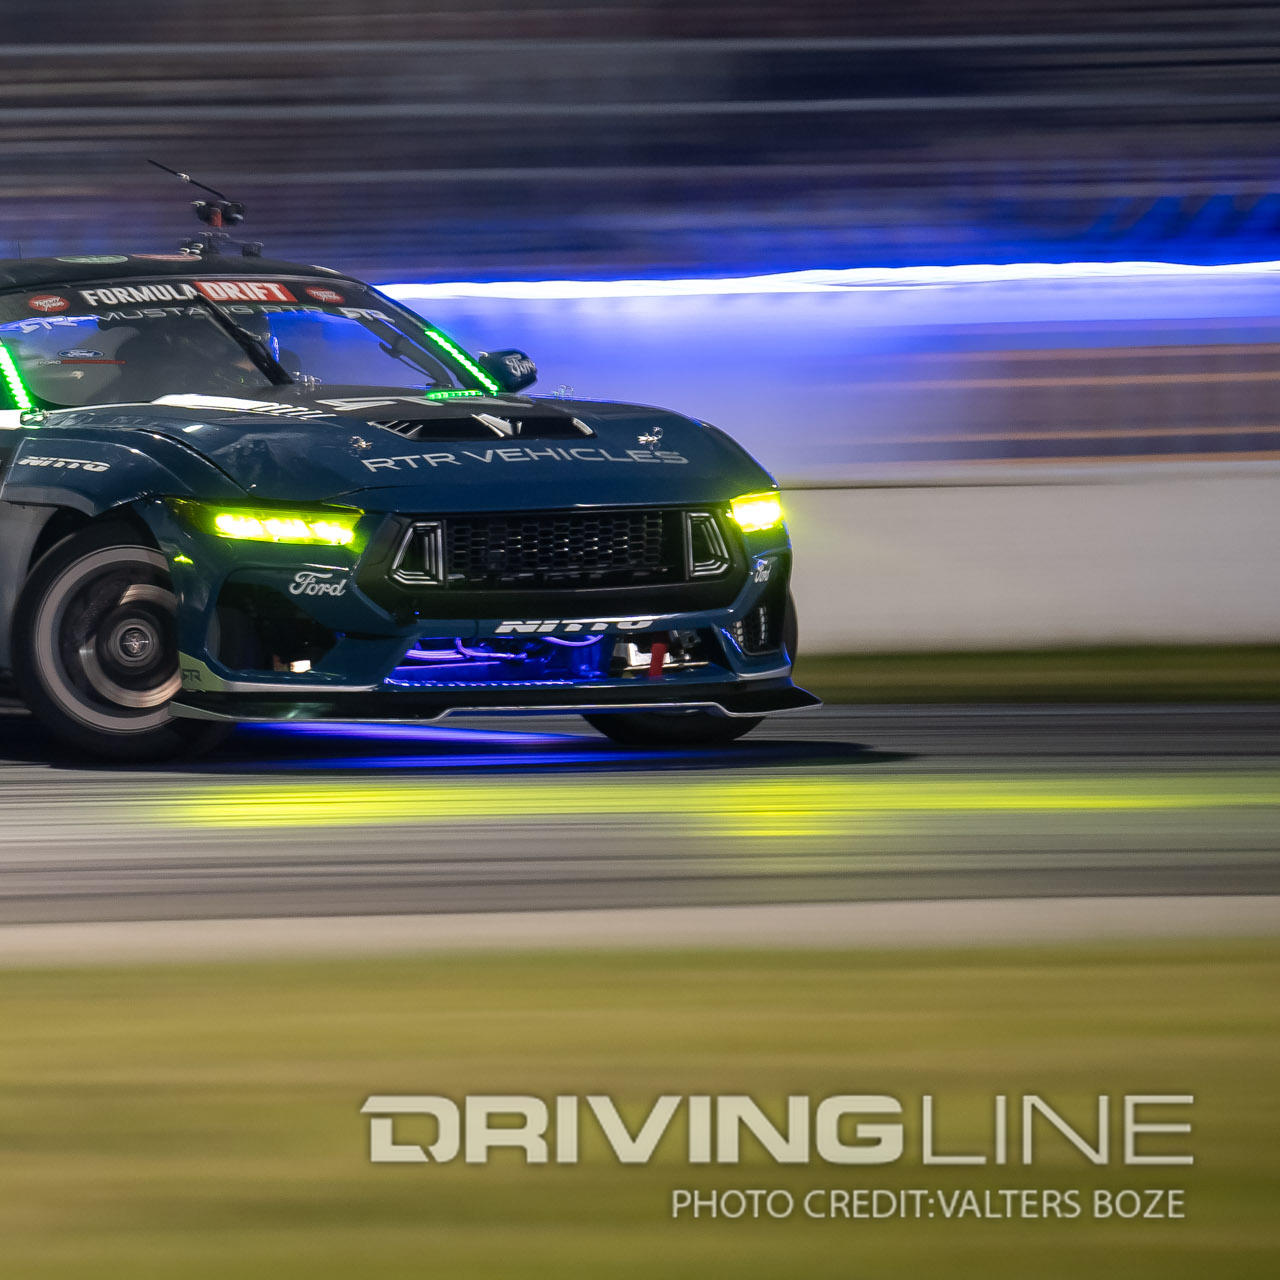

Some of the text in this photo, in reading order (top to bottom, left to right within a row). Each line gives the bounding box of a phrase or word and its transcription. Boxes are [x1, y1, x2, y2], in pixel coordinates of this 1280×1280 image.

[80, 284, 200, 306] FORMULA
[198, 281, 286, 301] DRIFT
[18, 455, 111, 472] NITTO
[360, 447, 688, 472] RTR VEHICLES
[289, 571, 346, 596] Ford
